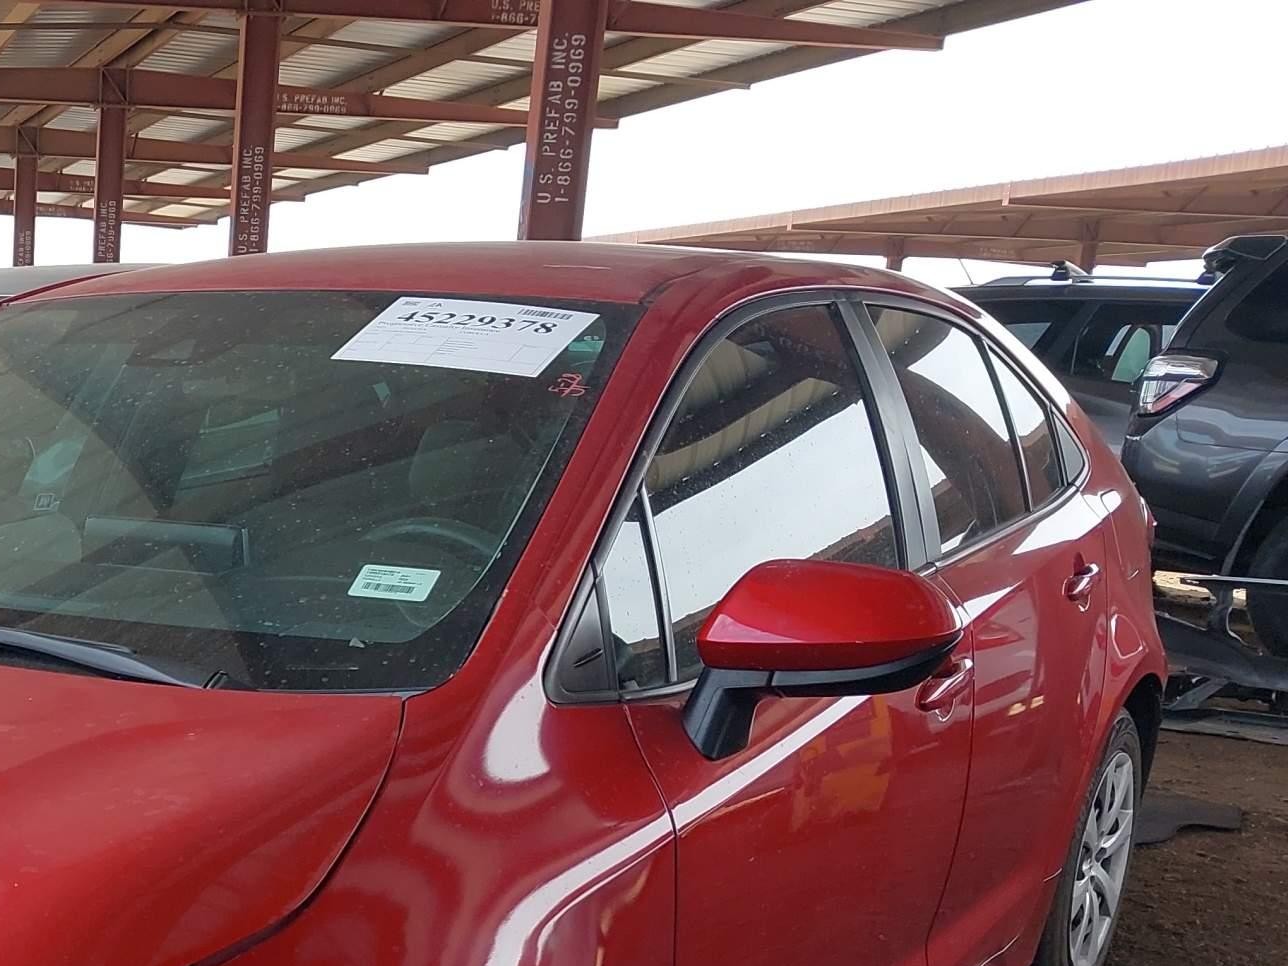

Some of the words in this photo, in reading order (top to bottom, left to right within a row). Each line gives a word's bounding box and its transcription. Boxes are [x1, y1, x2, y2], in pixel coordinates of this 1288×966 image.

[552, 32, 569, 69] INC.
[294, 93, 327, 104] PREFAB
[543, 80, 563, 156] PREFAB
[554, 34, 586, 202] 1-866-799-0969
[242, 145, 253, 169] INC.
[240, 175, 251, 223] PREFAB
[249, 146, 265, 252] 1-866-799-0969
[537, 168, 554, 204] U.S.
[238, 230, 249, 253] U.S.
[397, 311, 558, 335] 45229378
